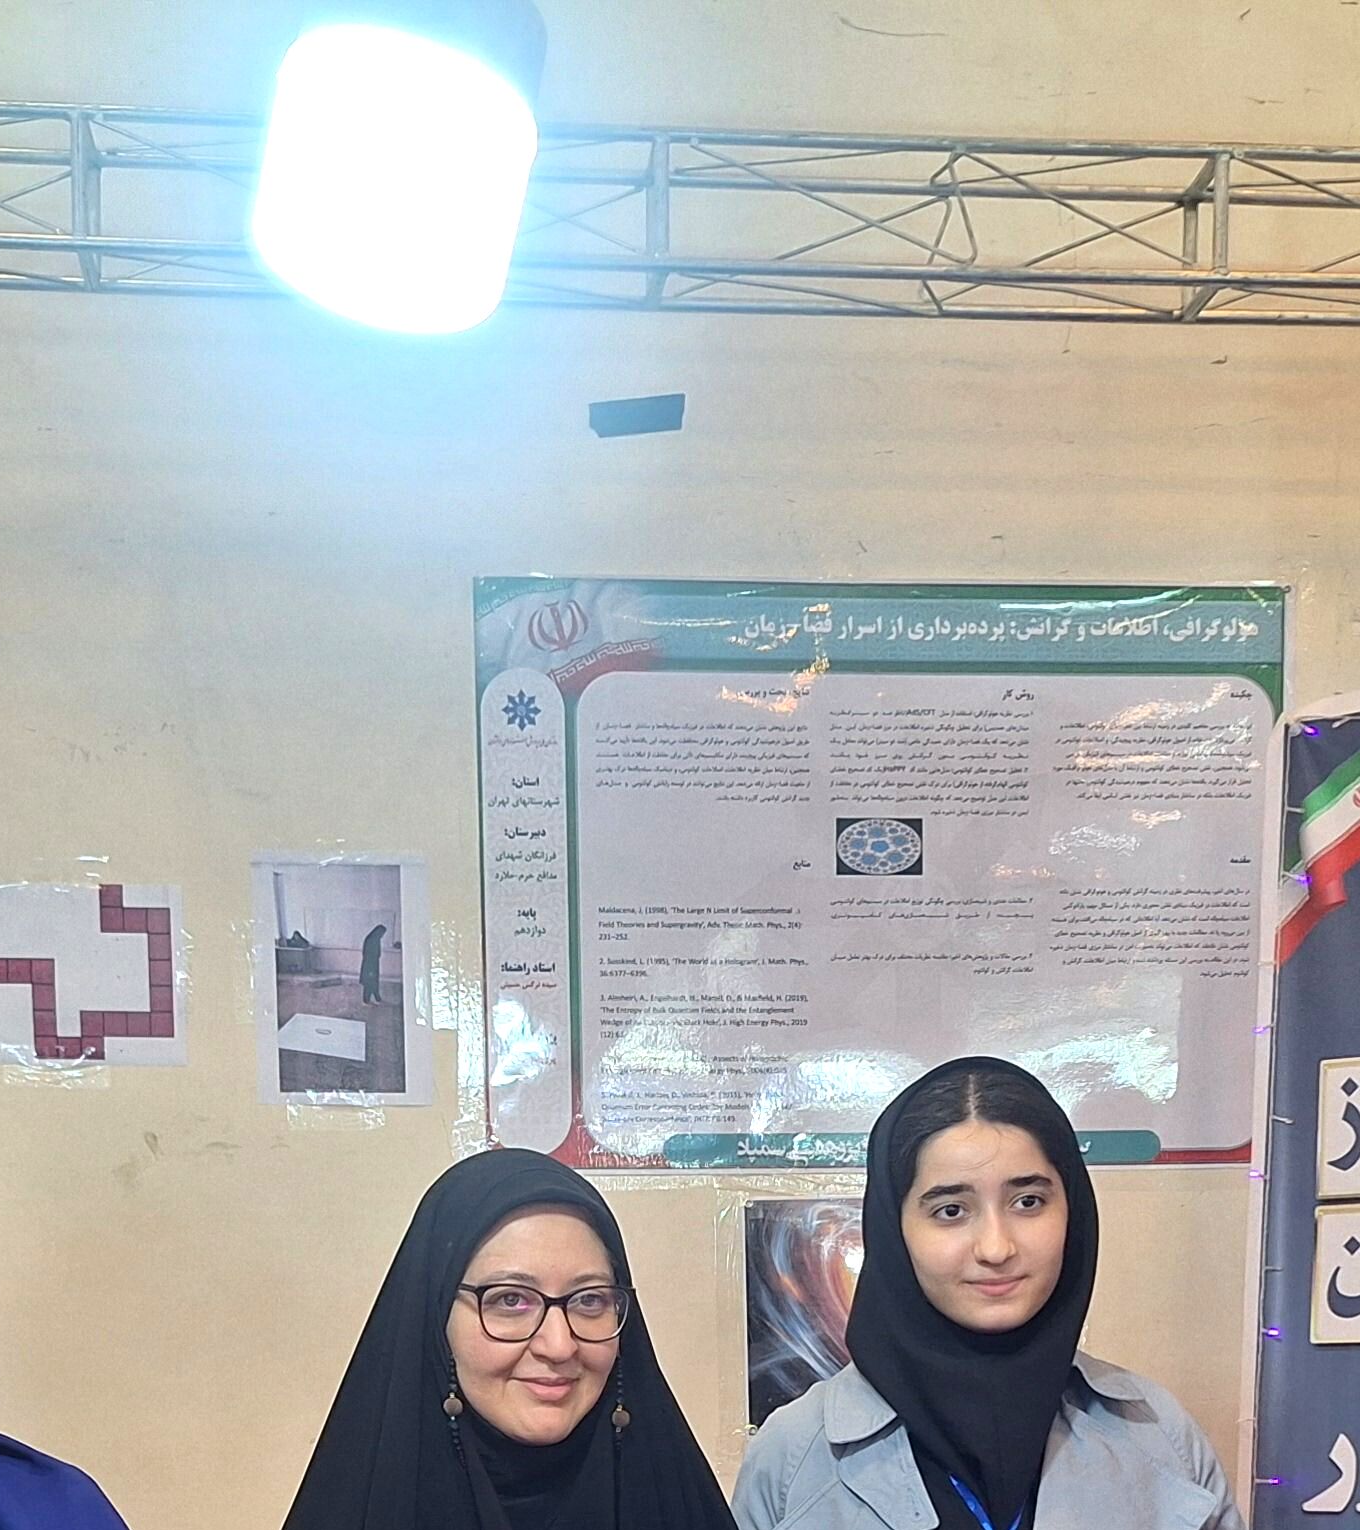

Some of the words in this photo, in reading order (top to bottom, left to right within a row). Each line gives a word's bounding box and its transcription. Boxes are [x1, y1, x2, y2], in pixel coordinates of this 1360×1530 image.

[837, 614, 883, 641] اسرار
[888, 615, 905, 641] از
[1010, 615, 1073, 642] گرانش:
